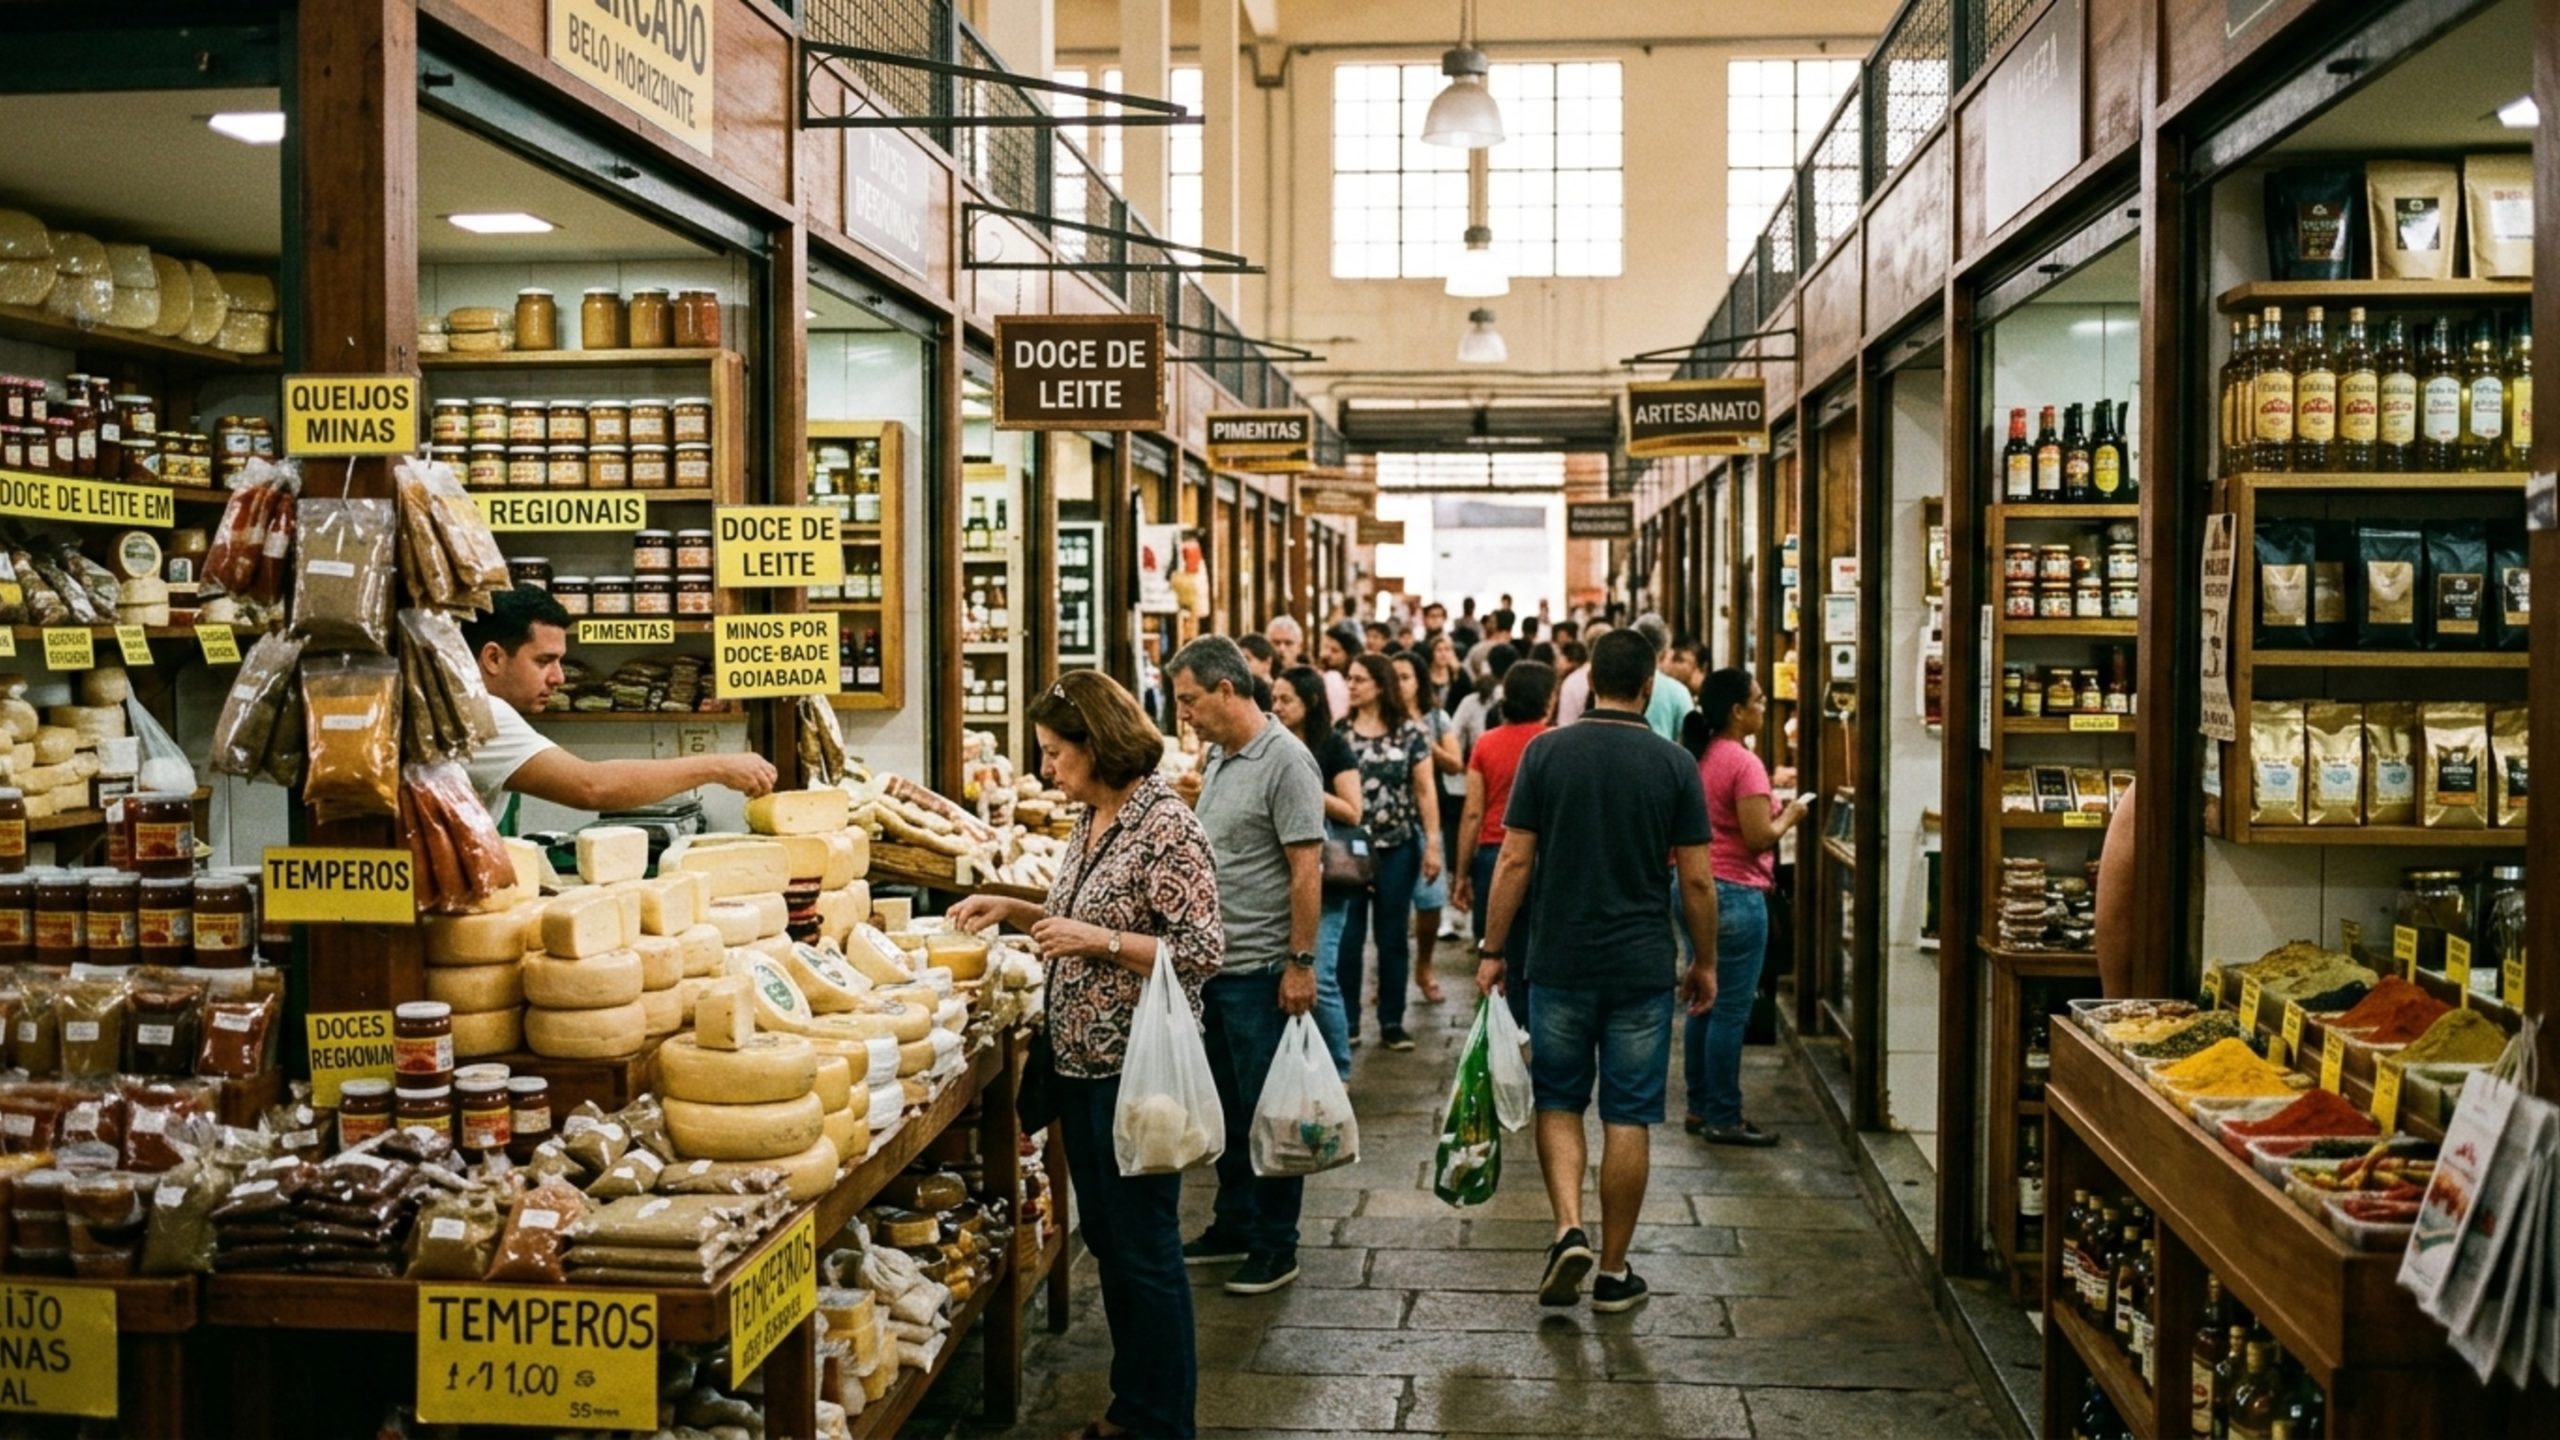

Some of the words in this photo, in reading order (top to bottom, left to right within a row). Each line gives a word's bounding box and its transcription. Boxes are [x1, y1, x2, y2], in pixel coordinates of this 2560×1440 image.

[568, 12, 611, 74] BELO
[614, 42, 697, 129] HORIZONTE
[1014, 340, 1097, 369] DOCE
[1106, 340, 1146, 369] DE
[292, 385, 409, 411] QUEIJOS
[1039, 380, 1122, 409] LEITE
[1635, 400, 1761, 424] ARTESANATO
[306, 417, 396, 443] MINAS
[1212, 422, 1301, 440] PIMENTAS
[0, 478, 51, 510] DOCE
[57, 485, 82, 513] DE
[87, 489, 139, 518] LEITE
[144, 494, 171, 520] EM
[490, 498, 641, 525] REGIONAIS
[721, 516, 792, 541] DOCE
[801, 516, 834, 541] DE
[743, 552, 816, 577] LEITE
[581, 623, 671, 641] PIMENTAS
[726, 621, 785, 640] MINOS
[790, 620, 828, 639] POR
[724, 644, 830, 664] DOCE-BADE
[729, 668, 827, 689] GOIABADA
[268, 859, 410, 892] TEMPEROS
[316, 1015, 385, 1041] DOCES
[428, 1297, 654, 1349] TEMPEROS
